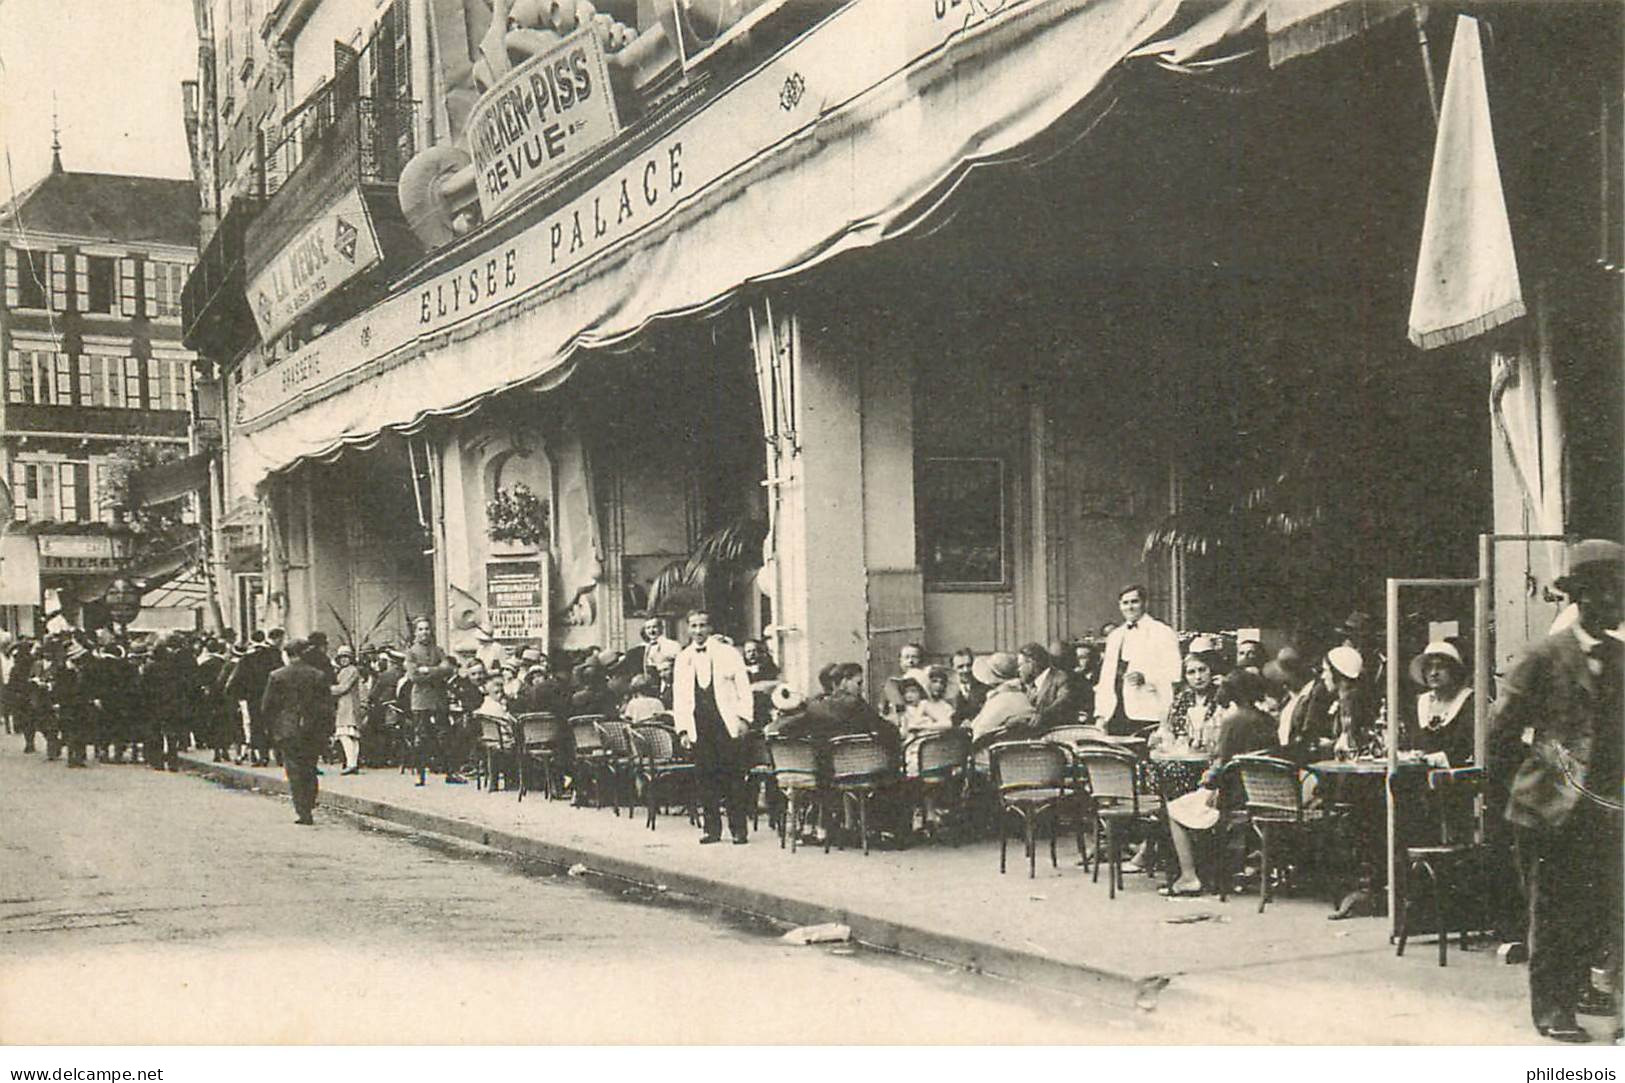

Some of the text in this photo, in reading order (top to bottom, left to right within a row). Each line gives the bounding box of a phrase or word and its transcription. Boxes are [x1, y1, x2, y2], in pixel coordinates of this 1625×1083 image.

[420, 248, 516, 324] ELYSEE
[551, 141, 683, 264] PALACE
[282, 351, 321, 392] BRASSERIE
